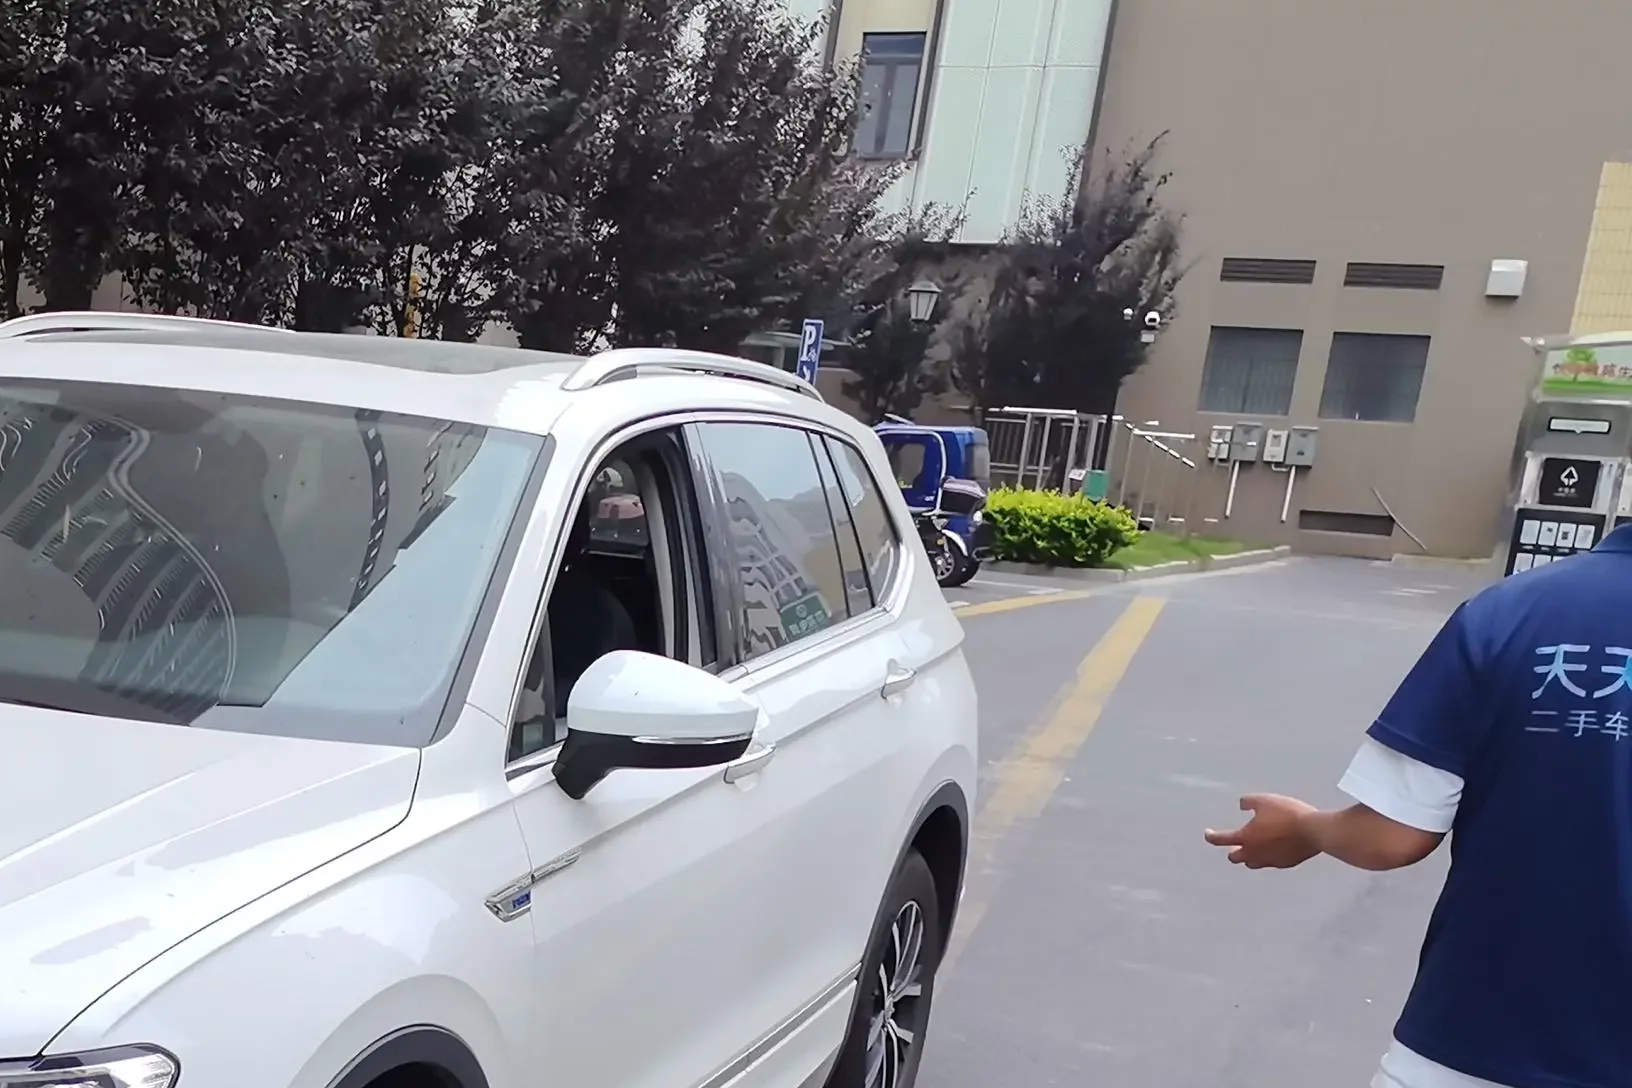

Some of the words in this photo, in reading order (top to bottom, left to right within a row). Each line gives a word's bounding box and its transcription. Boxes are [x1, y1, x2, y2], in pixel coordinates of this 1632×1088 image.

[800, 325, 817, 361] P
[1525, 710, 1629, 741] 二手车
